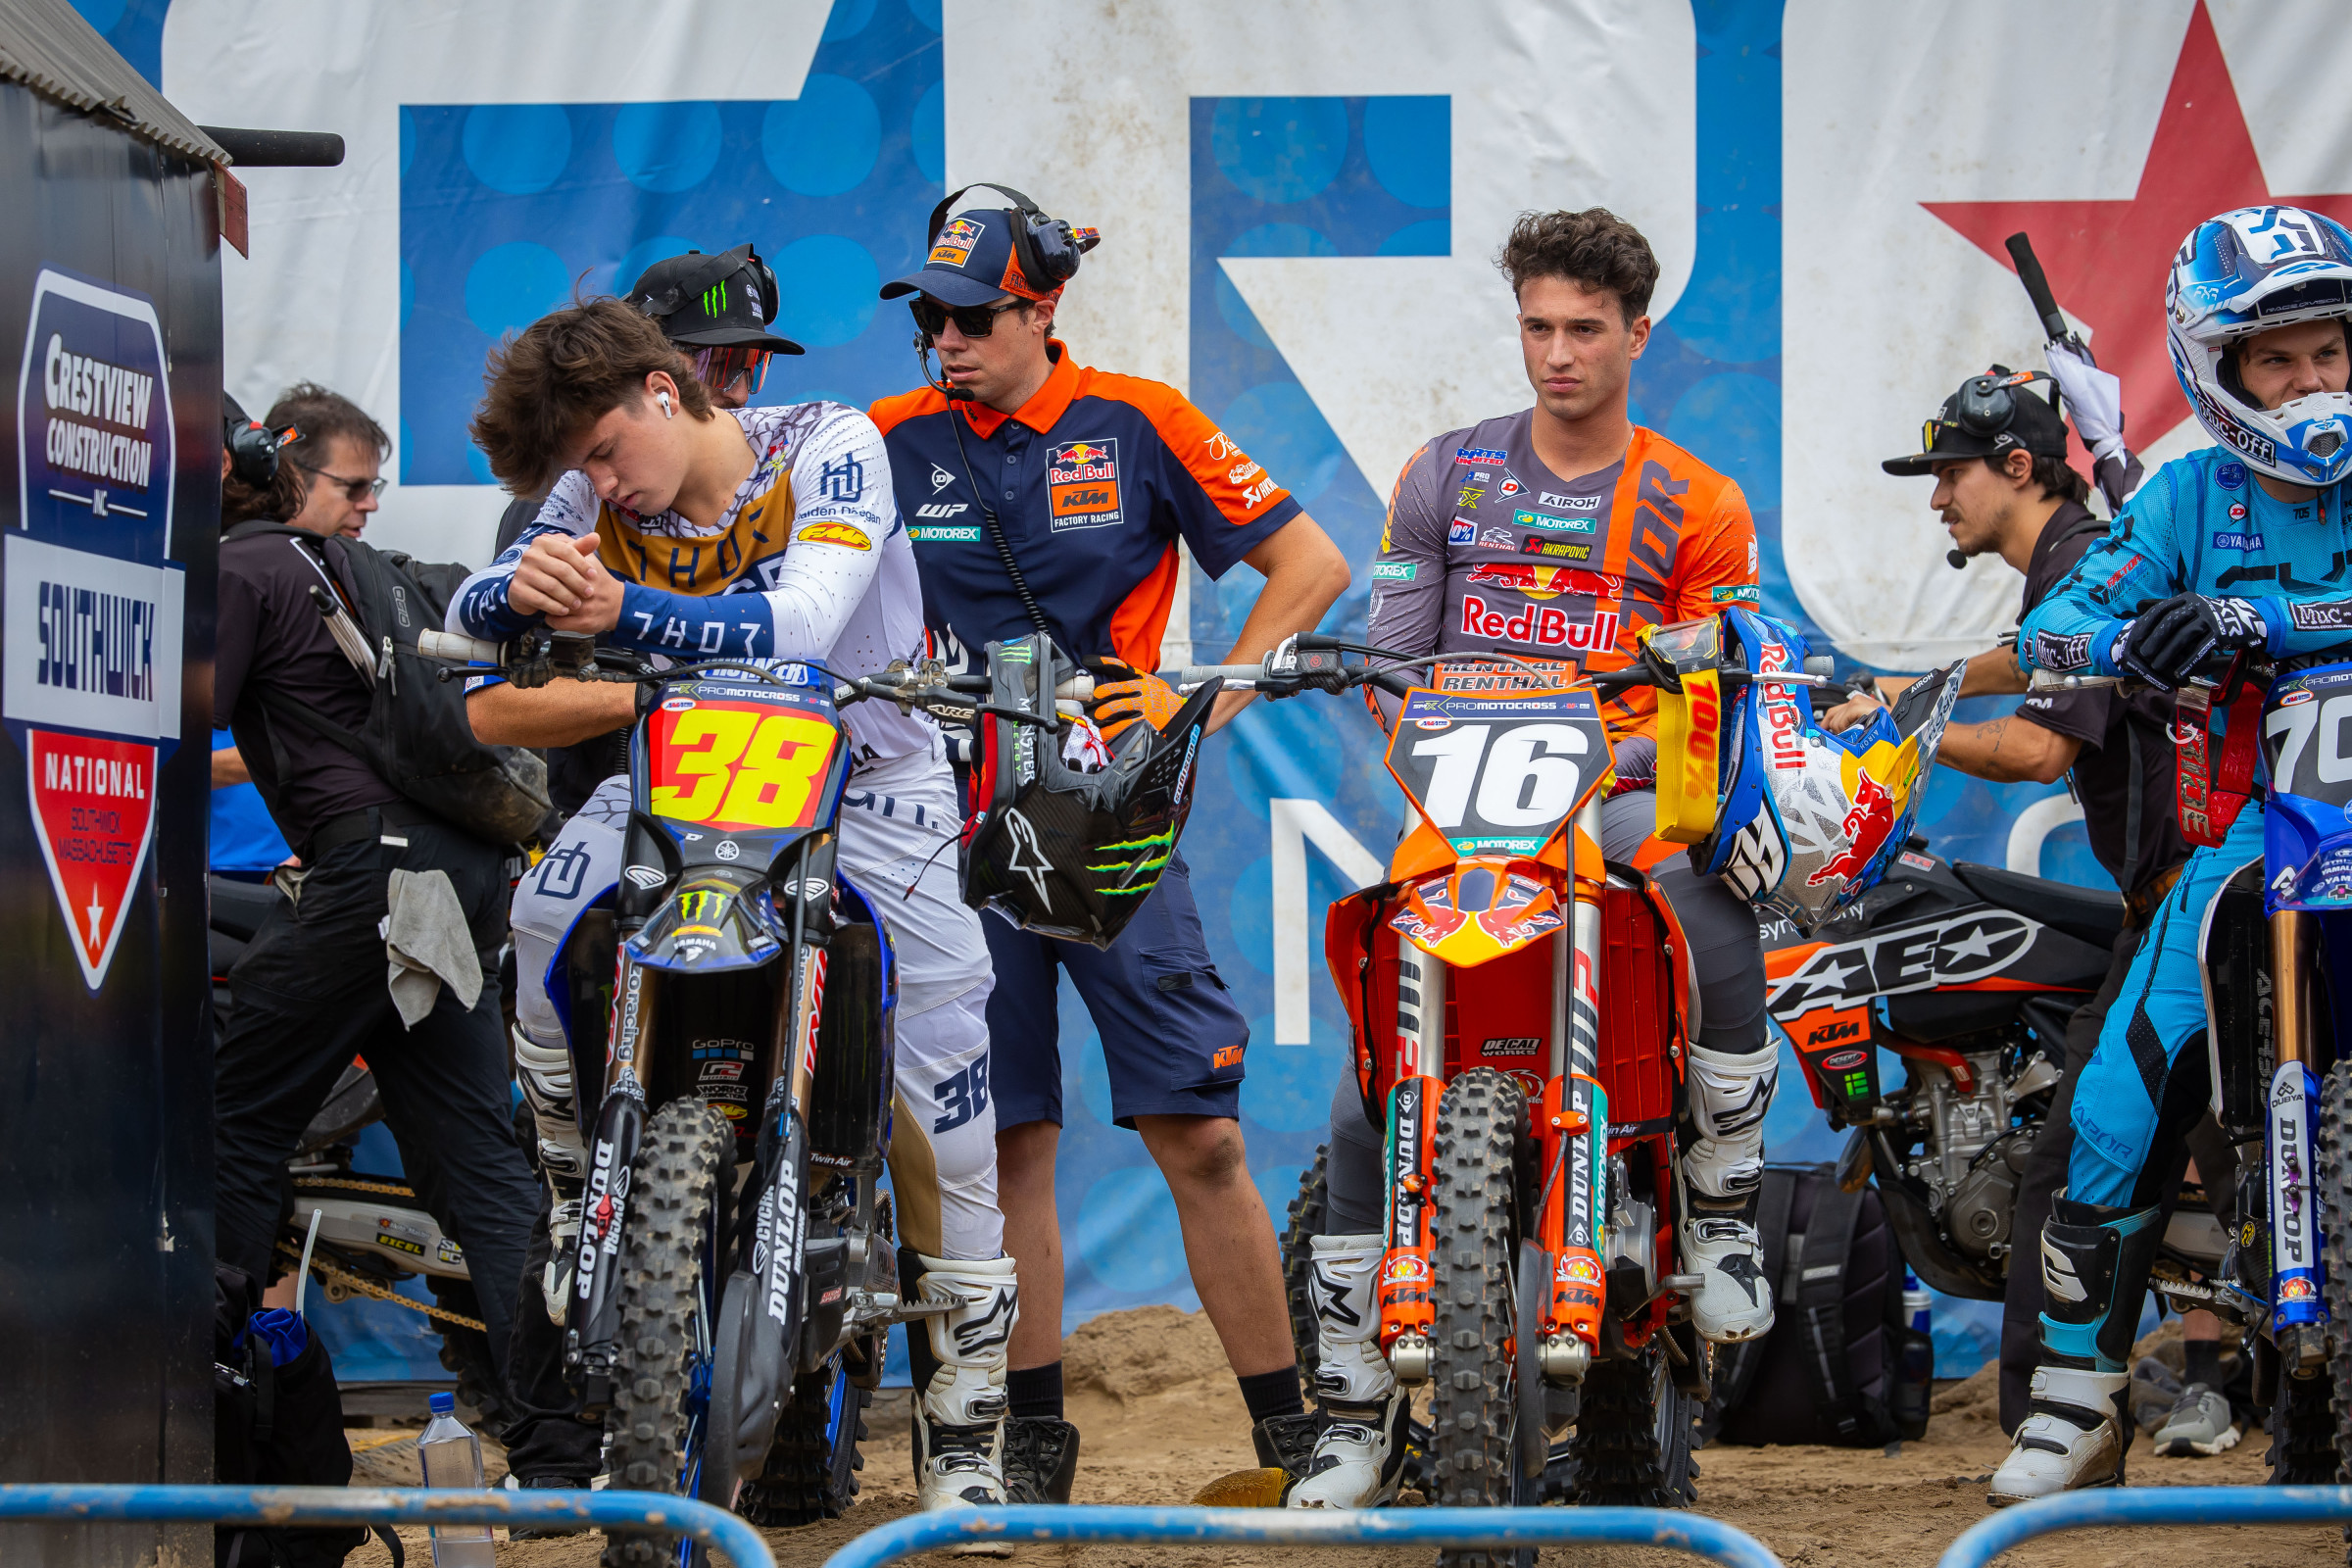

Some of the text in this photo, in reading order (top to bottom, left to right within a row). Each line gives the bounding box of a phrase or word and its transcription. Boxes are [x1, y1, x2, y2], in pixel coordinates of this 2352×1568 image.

[954, 236, 974, 250] Bull
[935, 250, 956, 260] KTM
[45, 333, 153, 429] CRESTVIEW
[46, 417, 151, 487] CONSTRUCTION
[1455, 457, 1504, 466] UNMITED
[1051, 463, 1115, 483] Red Bull
[1061, 489, 1109, 508] KTM
[1543, 495, 1598, 509] AIROH
[797, 507, 837, 521] aiden
[915, 504, 969, 518] WP
[1054, 512, 1119, 527] FACTORY RACING
[920, 526, 978, 540] MOTOREX
[1536, 515, 1591, 531] MOTOREX
[806, 525, 871, 548] FMF
[1478, 541, 1517, 552] RENTHAL
[2228, 535, 2263, 550] YAMAHA
[1373, 564, 1408, 577] OTOREX
[1461, 595, 1620, 653] Red Bull
[37, 581, 154, 702] SOUTHWICK
[1441, 675, 1568, 691] RENTHAL
[1910, 672, 1935, 694] AIROH
[927, 704, 976, 719] ARC
[1012, 720, 1021, 772] NERGY
[1018, 697, 1036, 784] MNSTER
[1685, 678, 1719, 800] 100%
[1767, 706, 1807, 770] Bull
[45, 752, 145, 800] NATIONAL
[650, 709, 838, 828] 38
[1411, 723, 1589, 828] 16
[71, 808, 122, 834] SOUTHWICK
[58, 838, 132, 866] MASSACHUSETTS
[1477, 840, 1538, 851] MOTOREX
[673, 938, 717, 952] YAMAHA
[616, 962, 643, 1062] zoracing
[692, 1039, 755, 1051] GoPro
[1806, 1021, 1860, 1048] KTM
[1212, 1045, 1244, 1069] KTM
[700, 1085, 747, 1095] WORKS
[933, 1050, 990, 1135] 38
[2271, 1093, 2305, 1108] DUBYA
[1621, 1125, 1639, 1135] Air
[809, 1152, 853, 1167] Twin Air
[1572, 1090, 1589, 1221] DUNLP
[576, 1138, 614, 1300] DUNLOP
[603, 1196, 625, 1255] CYCRA
[378, 1235, 422, 1254] EXCEL
[767, 1159, 799, 1326] DUNLOP
[1382, 1288, 1428, 1309] KTM
[1555, 1288, 1601, 1309] KTM
